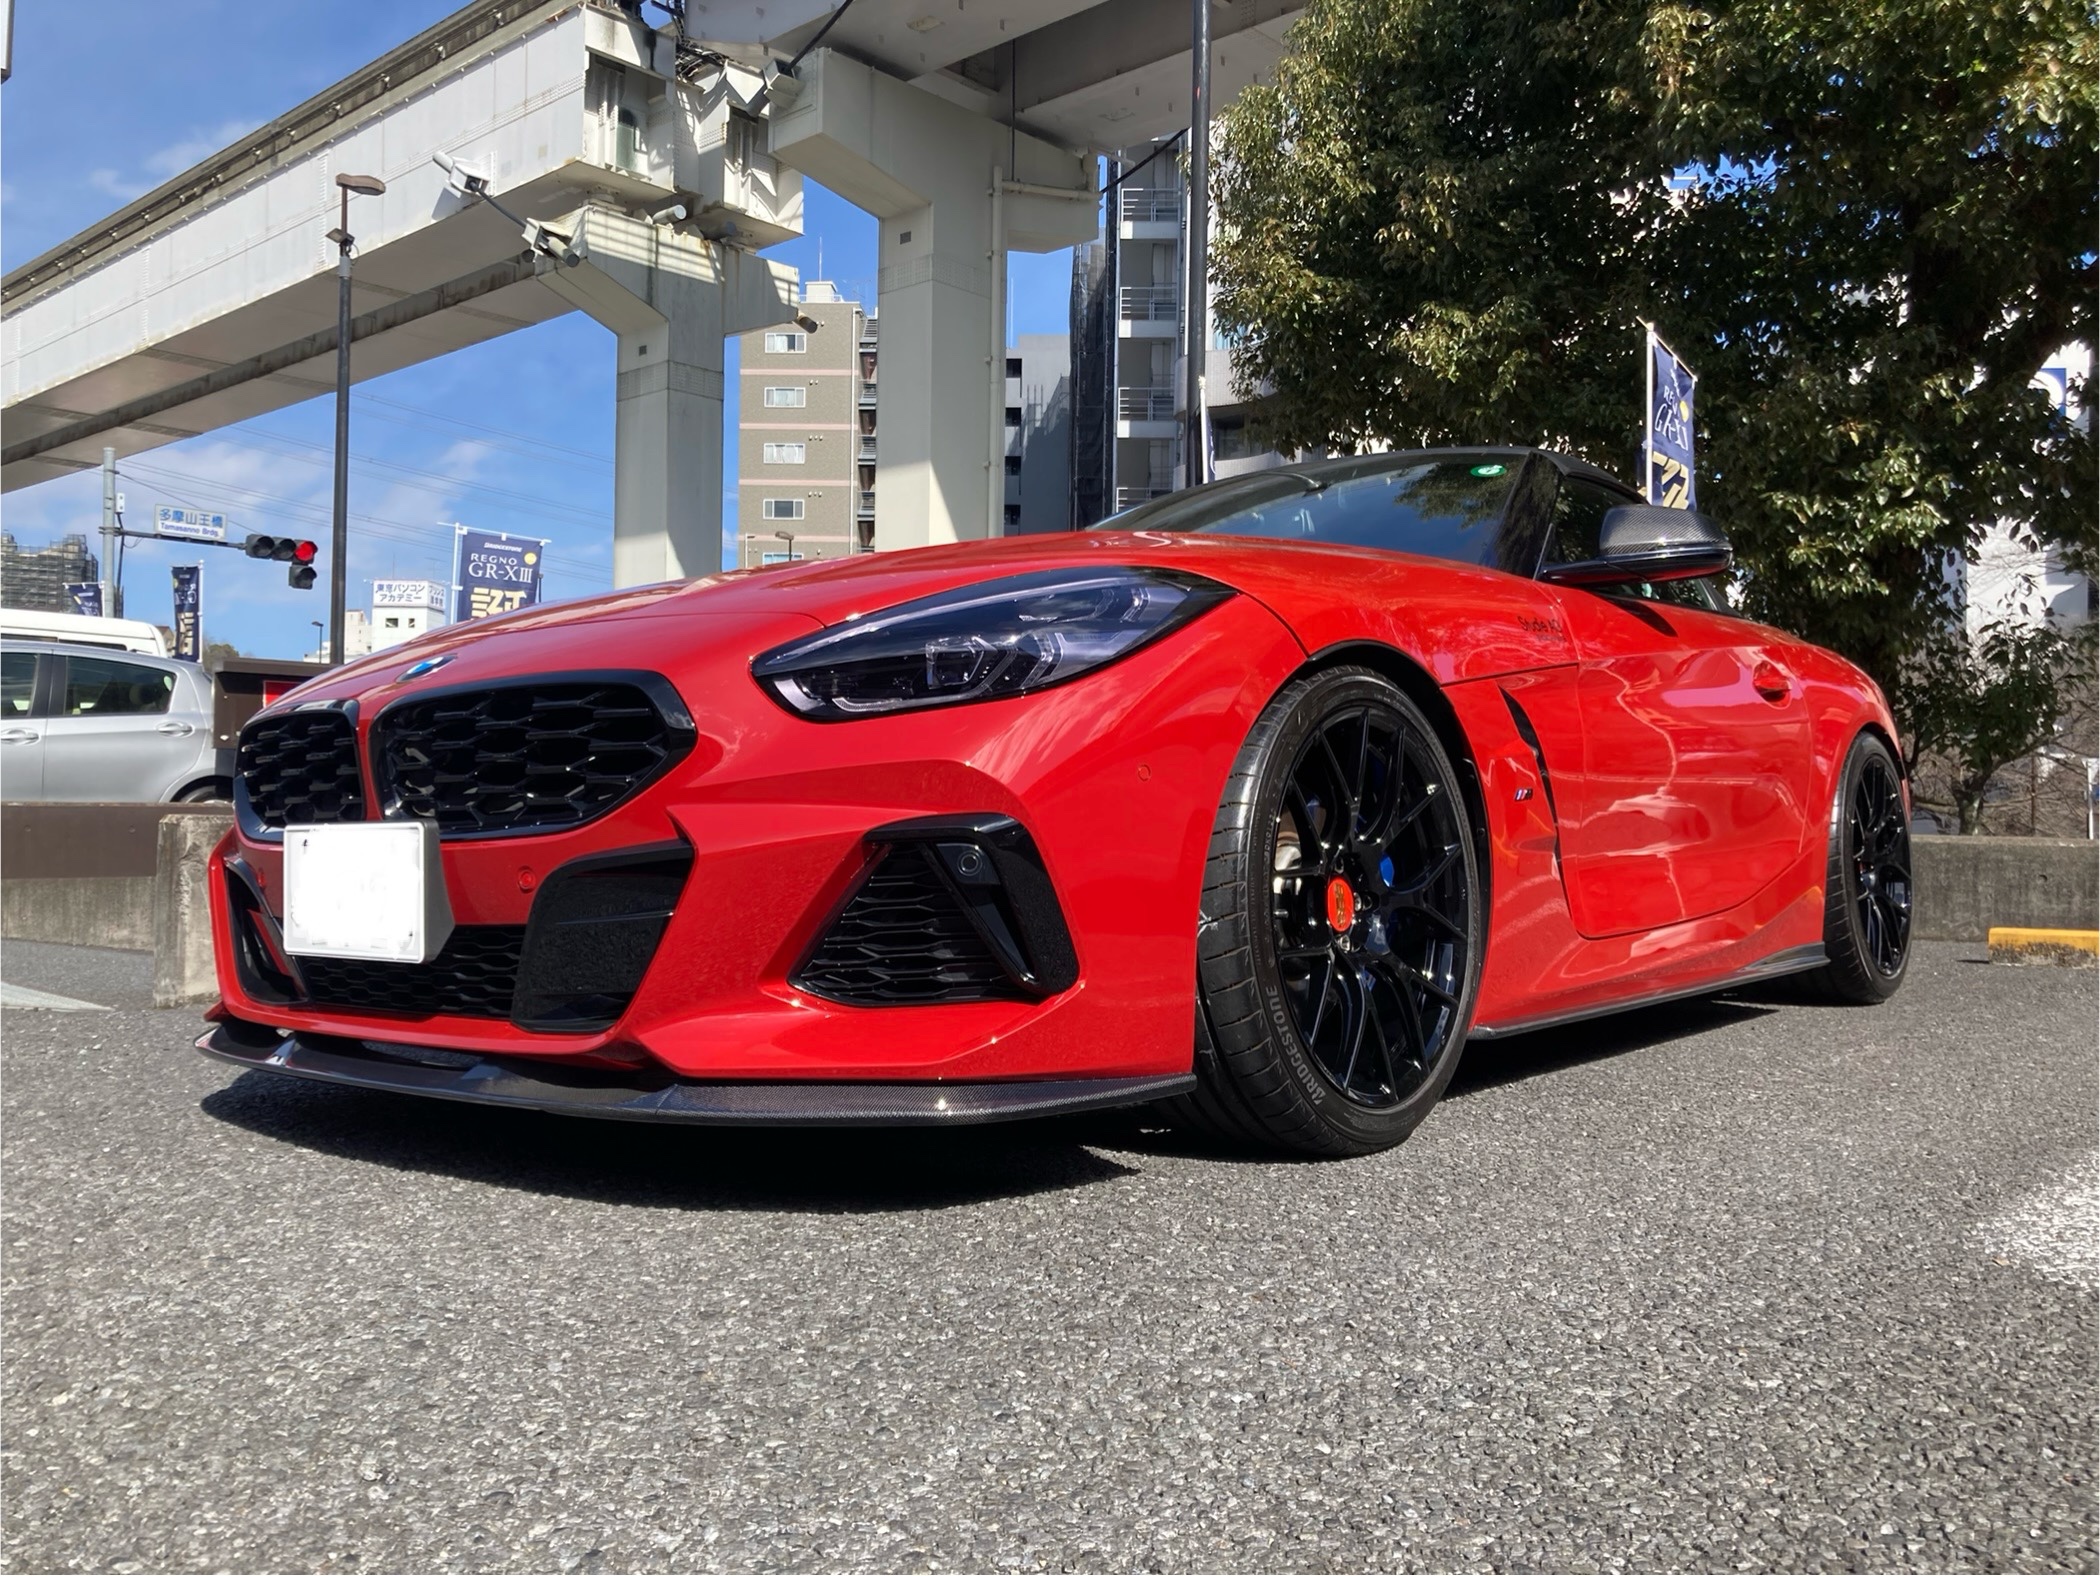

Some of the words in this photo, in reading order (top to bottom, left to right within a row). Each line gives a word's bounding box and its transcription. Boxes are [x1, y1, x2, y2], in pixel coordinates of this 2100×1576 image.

[470, 553, 517, 566] REGNO
[375, 583, 426, 595] 東京パソコン
[379, 593, 422, 602] アカデミー
[1265, 984, 1326, 1106] BRIDGESTONE
